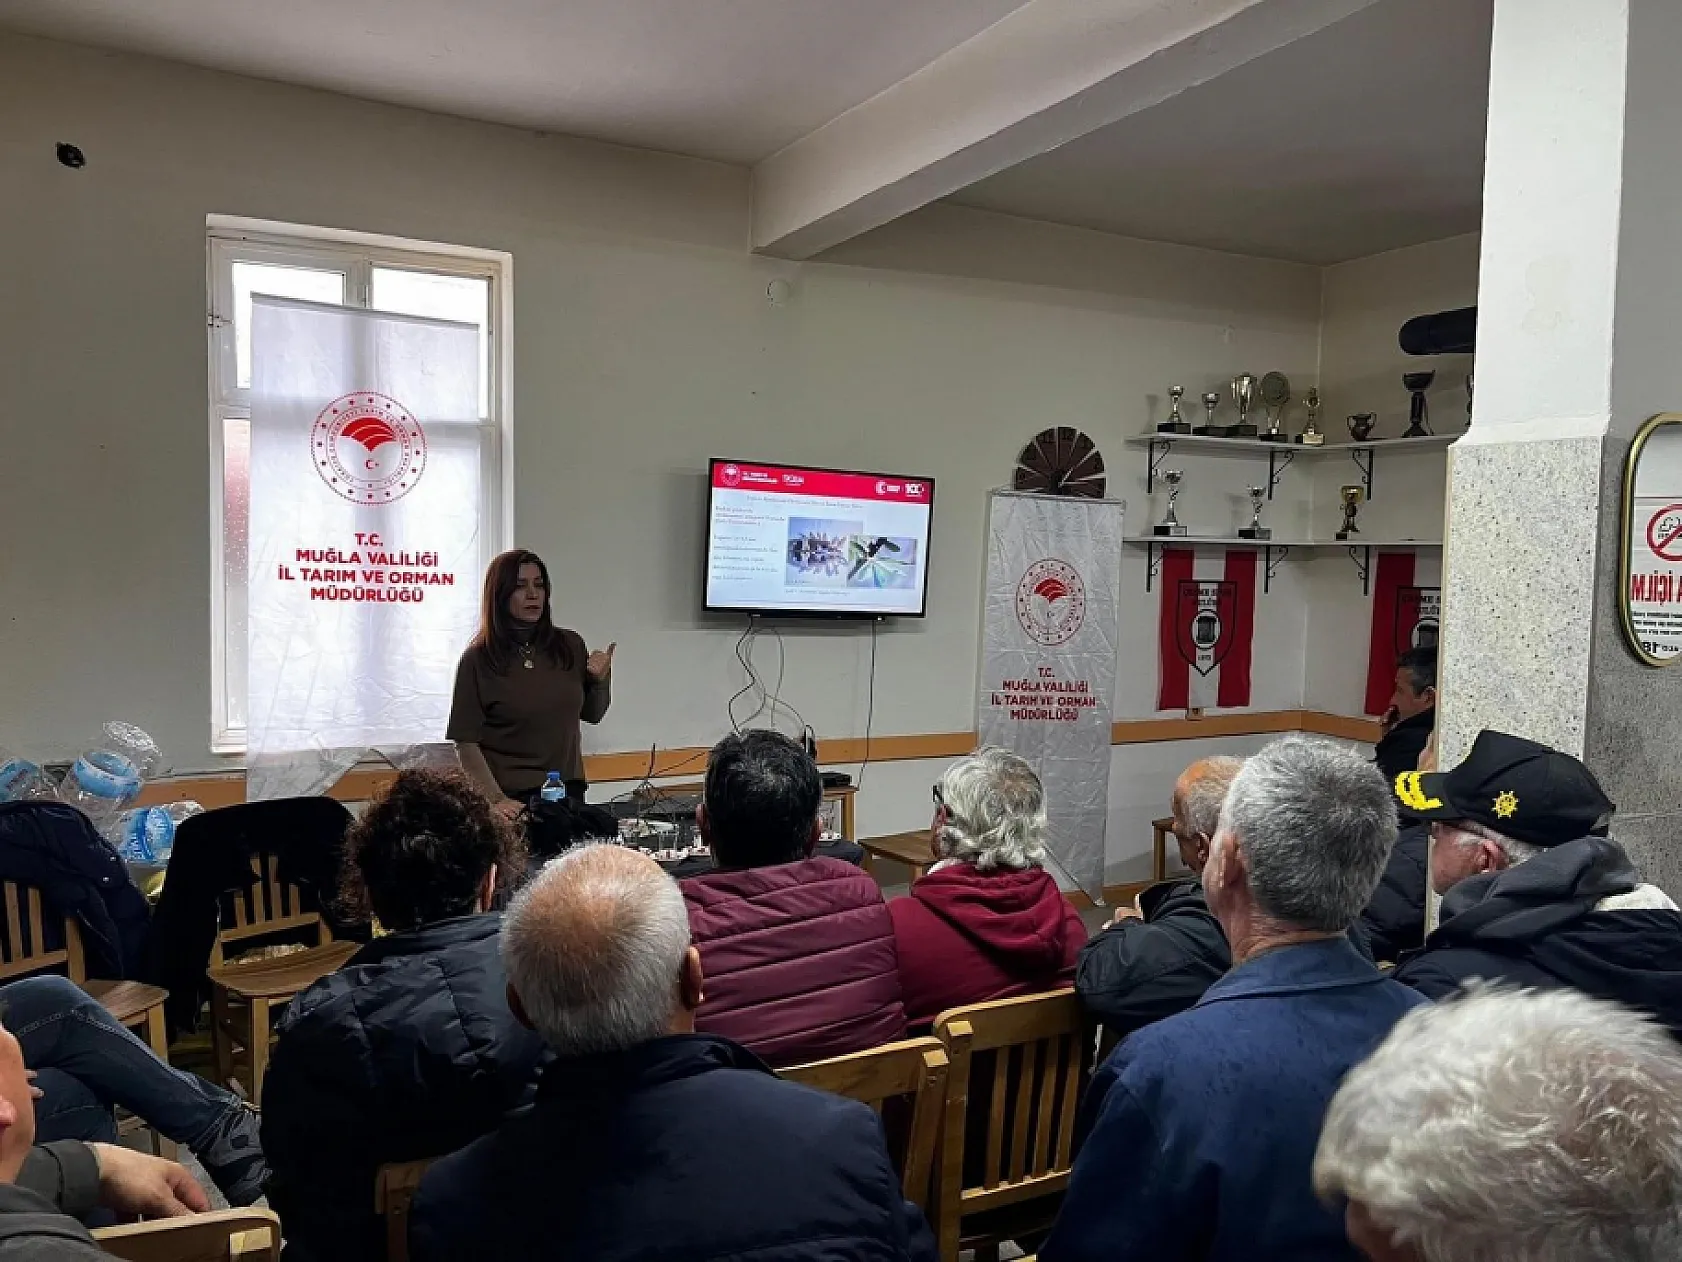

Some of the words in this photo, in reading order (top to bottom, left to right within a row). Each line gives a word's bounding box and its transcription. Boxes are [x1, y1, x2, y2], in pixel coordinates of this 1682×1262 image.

[355, 533, 383, 547] T.C.
[296, 548, 361, 564] MUĞLA
[368, 550, 438, 568] VALİLİĞİ
[278, 564, 295, 581] İL
[300, 568, 355, 583] TARIM
[362, 570, 383, 584] VE
[389, 571, 454, 586] ORMAN
[311, 585, 424, 602] MÜDÜRLÜĞÜ
[1037, 667, 1055, 678] T.C.
[1002, 679, 1041, 692] MUĞLA
[1043, 680, 1088, 693] VALİLİĞİ
[991, 692, 1002, 706] İL
[1004, 695, 1037, 706] TARIM
[1057, 696, 1096, 707] ORMAN
[1009, 707, 1080, 721] MÜDÜRLÜĞÜ
